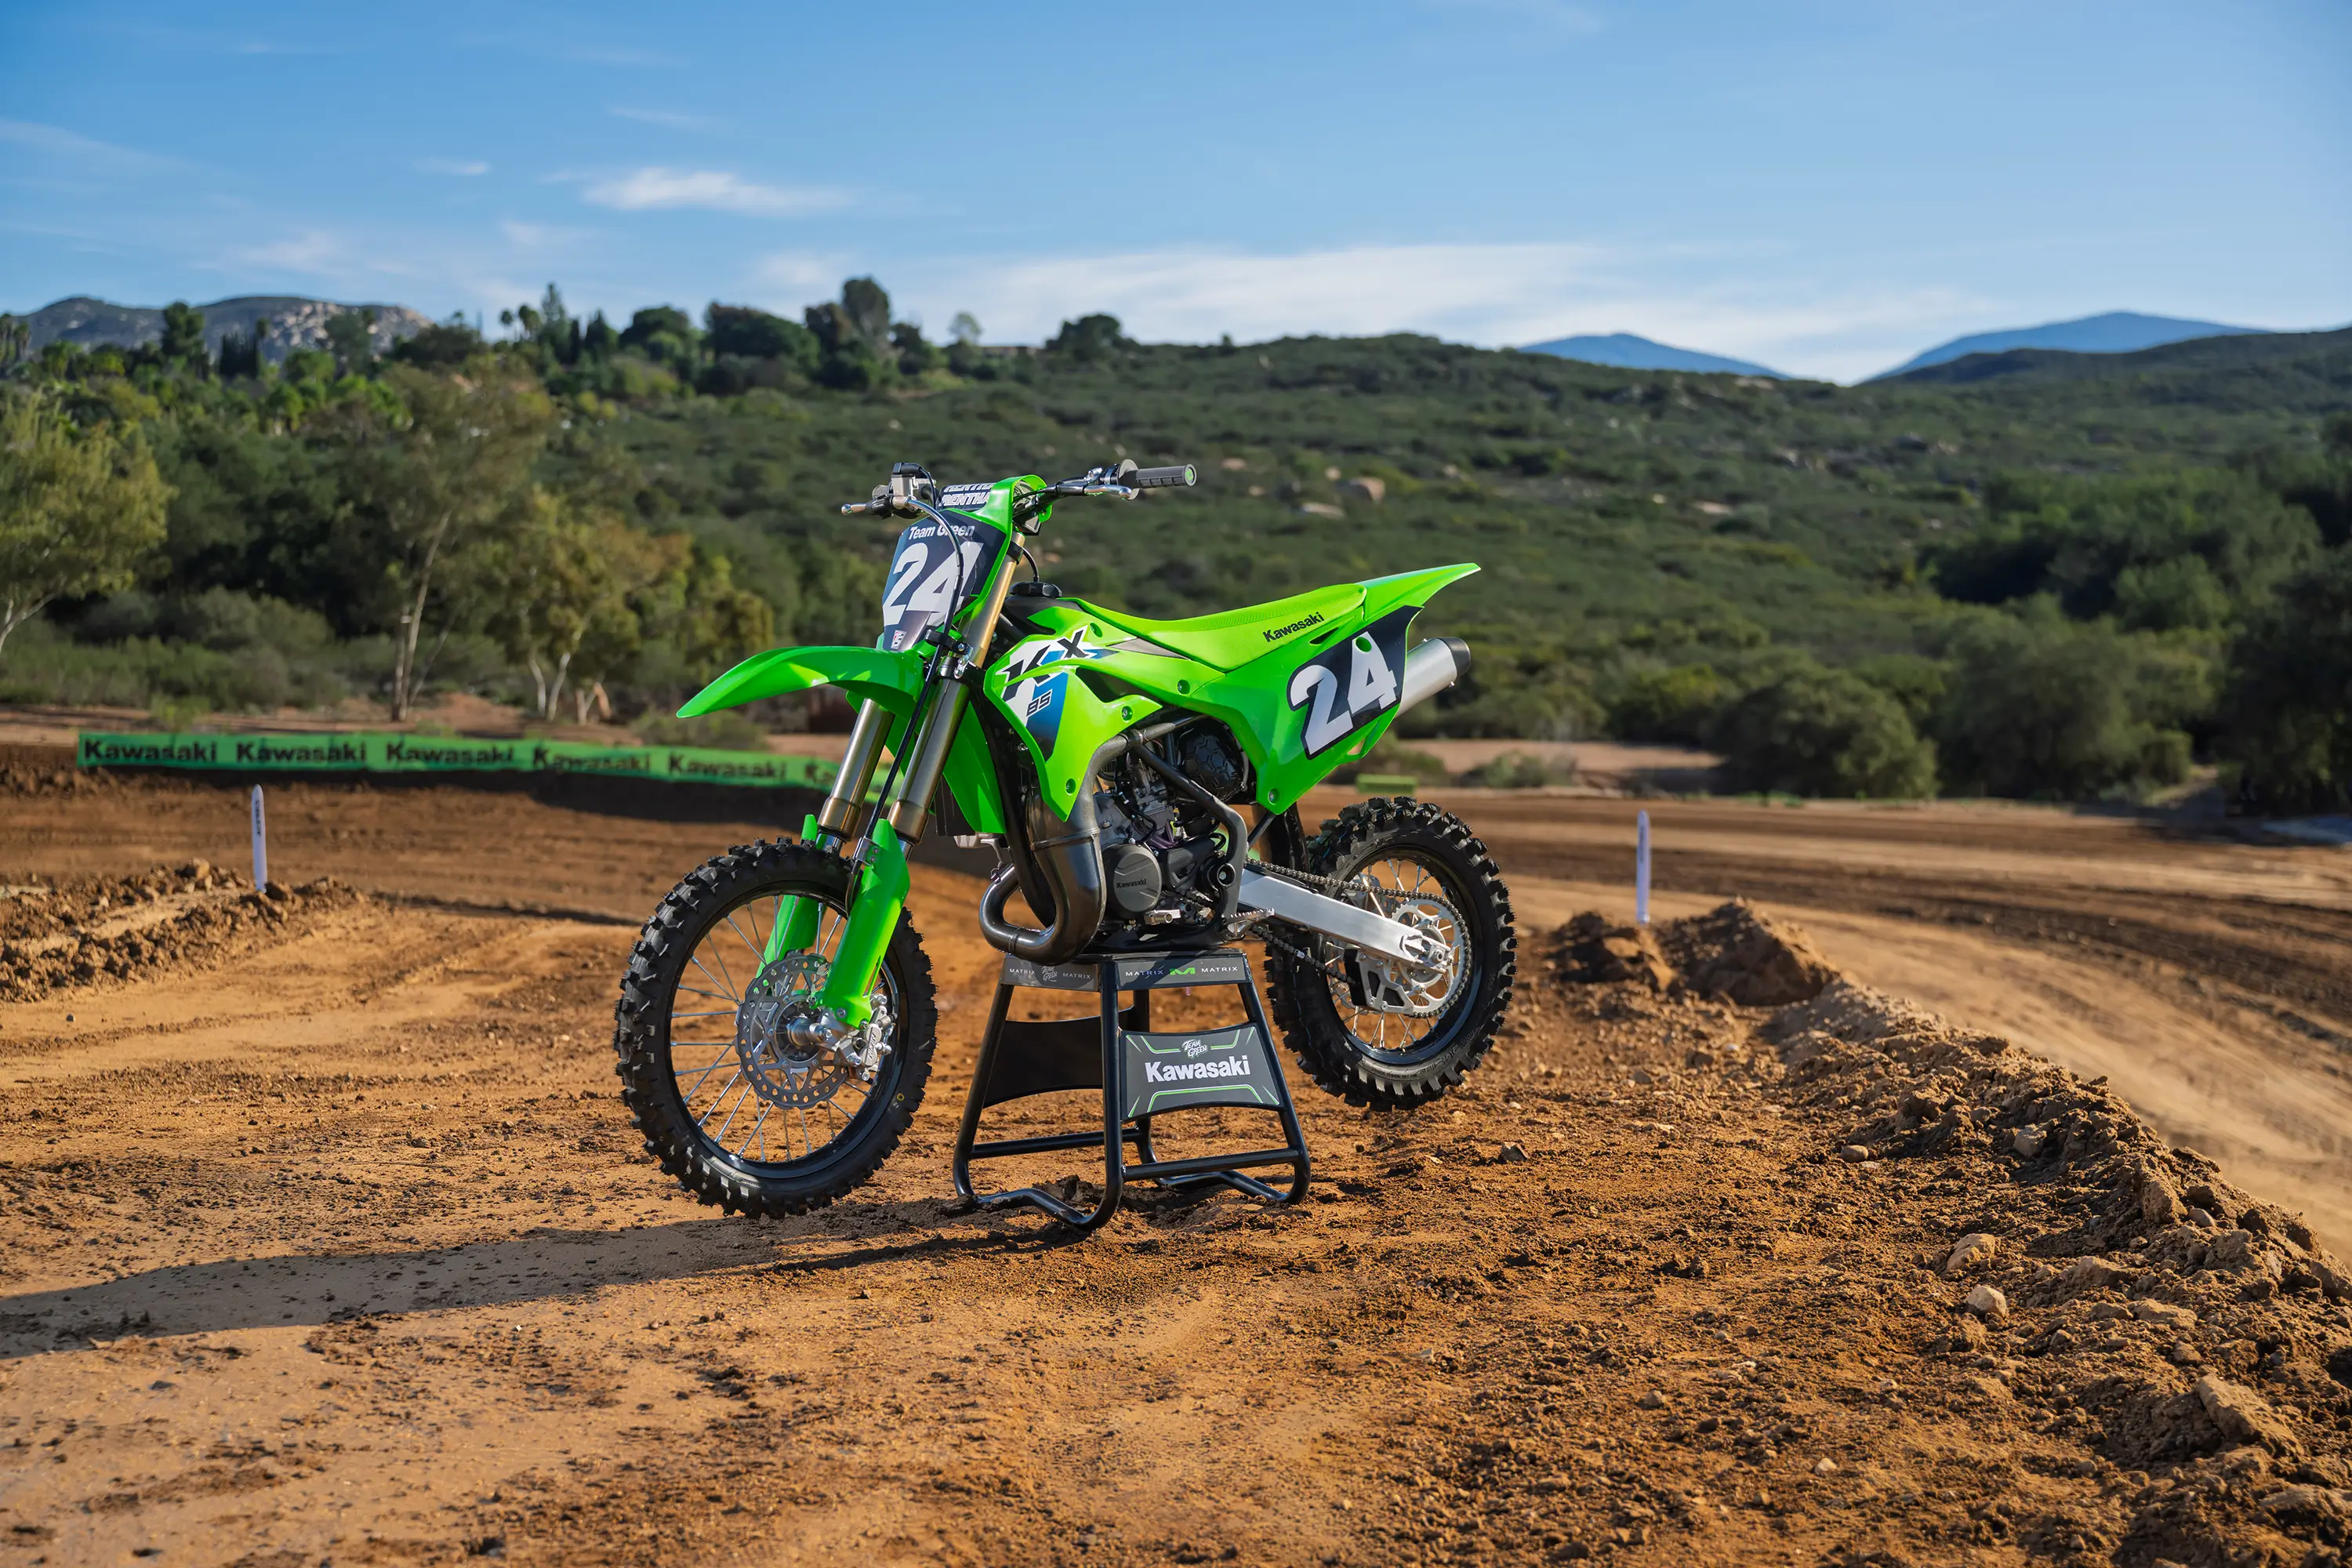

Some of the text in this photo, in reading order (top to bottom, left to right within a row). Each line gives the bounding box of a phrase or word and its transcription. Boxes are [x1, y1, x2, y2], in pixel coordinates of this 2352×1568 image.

[908, 526, 935, 540] Team
[883, 542, 984, 627] 24
[1263, 612, 1325, 643] Kawasaki
[1026, 689, 1052, 717] 85
[1289, 630, 1398, 757] 24
[84, 740, 217, 762] Kawasaki
[237, 740, 367, 762] Kawasaki
[386, 741, 514, 763] Kawasaki
[1116, 879, 1147, 889] Kawasaki
[1181, 1039, 1201, 1051] TEAM
[1188, 1045, 1208, 1058] GREEN
[1145, 1054, 1250, 1083] Kawasaki
